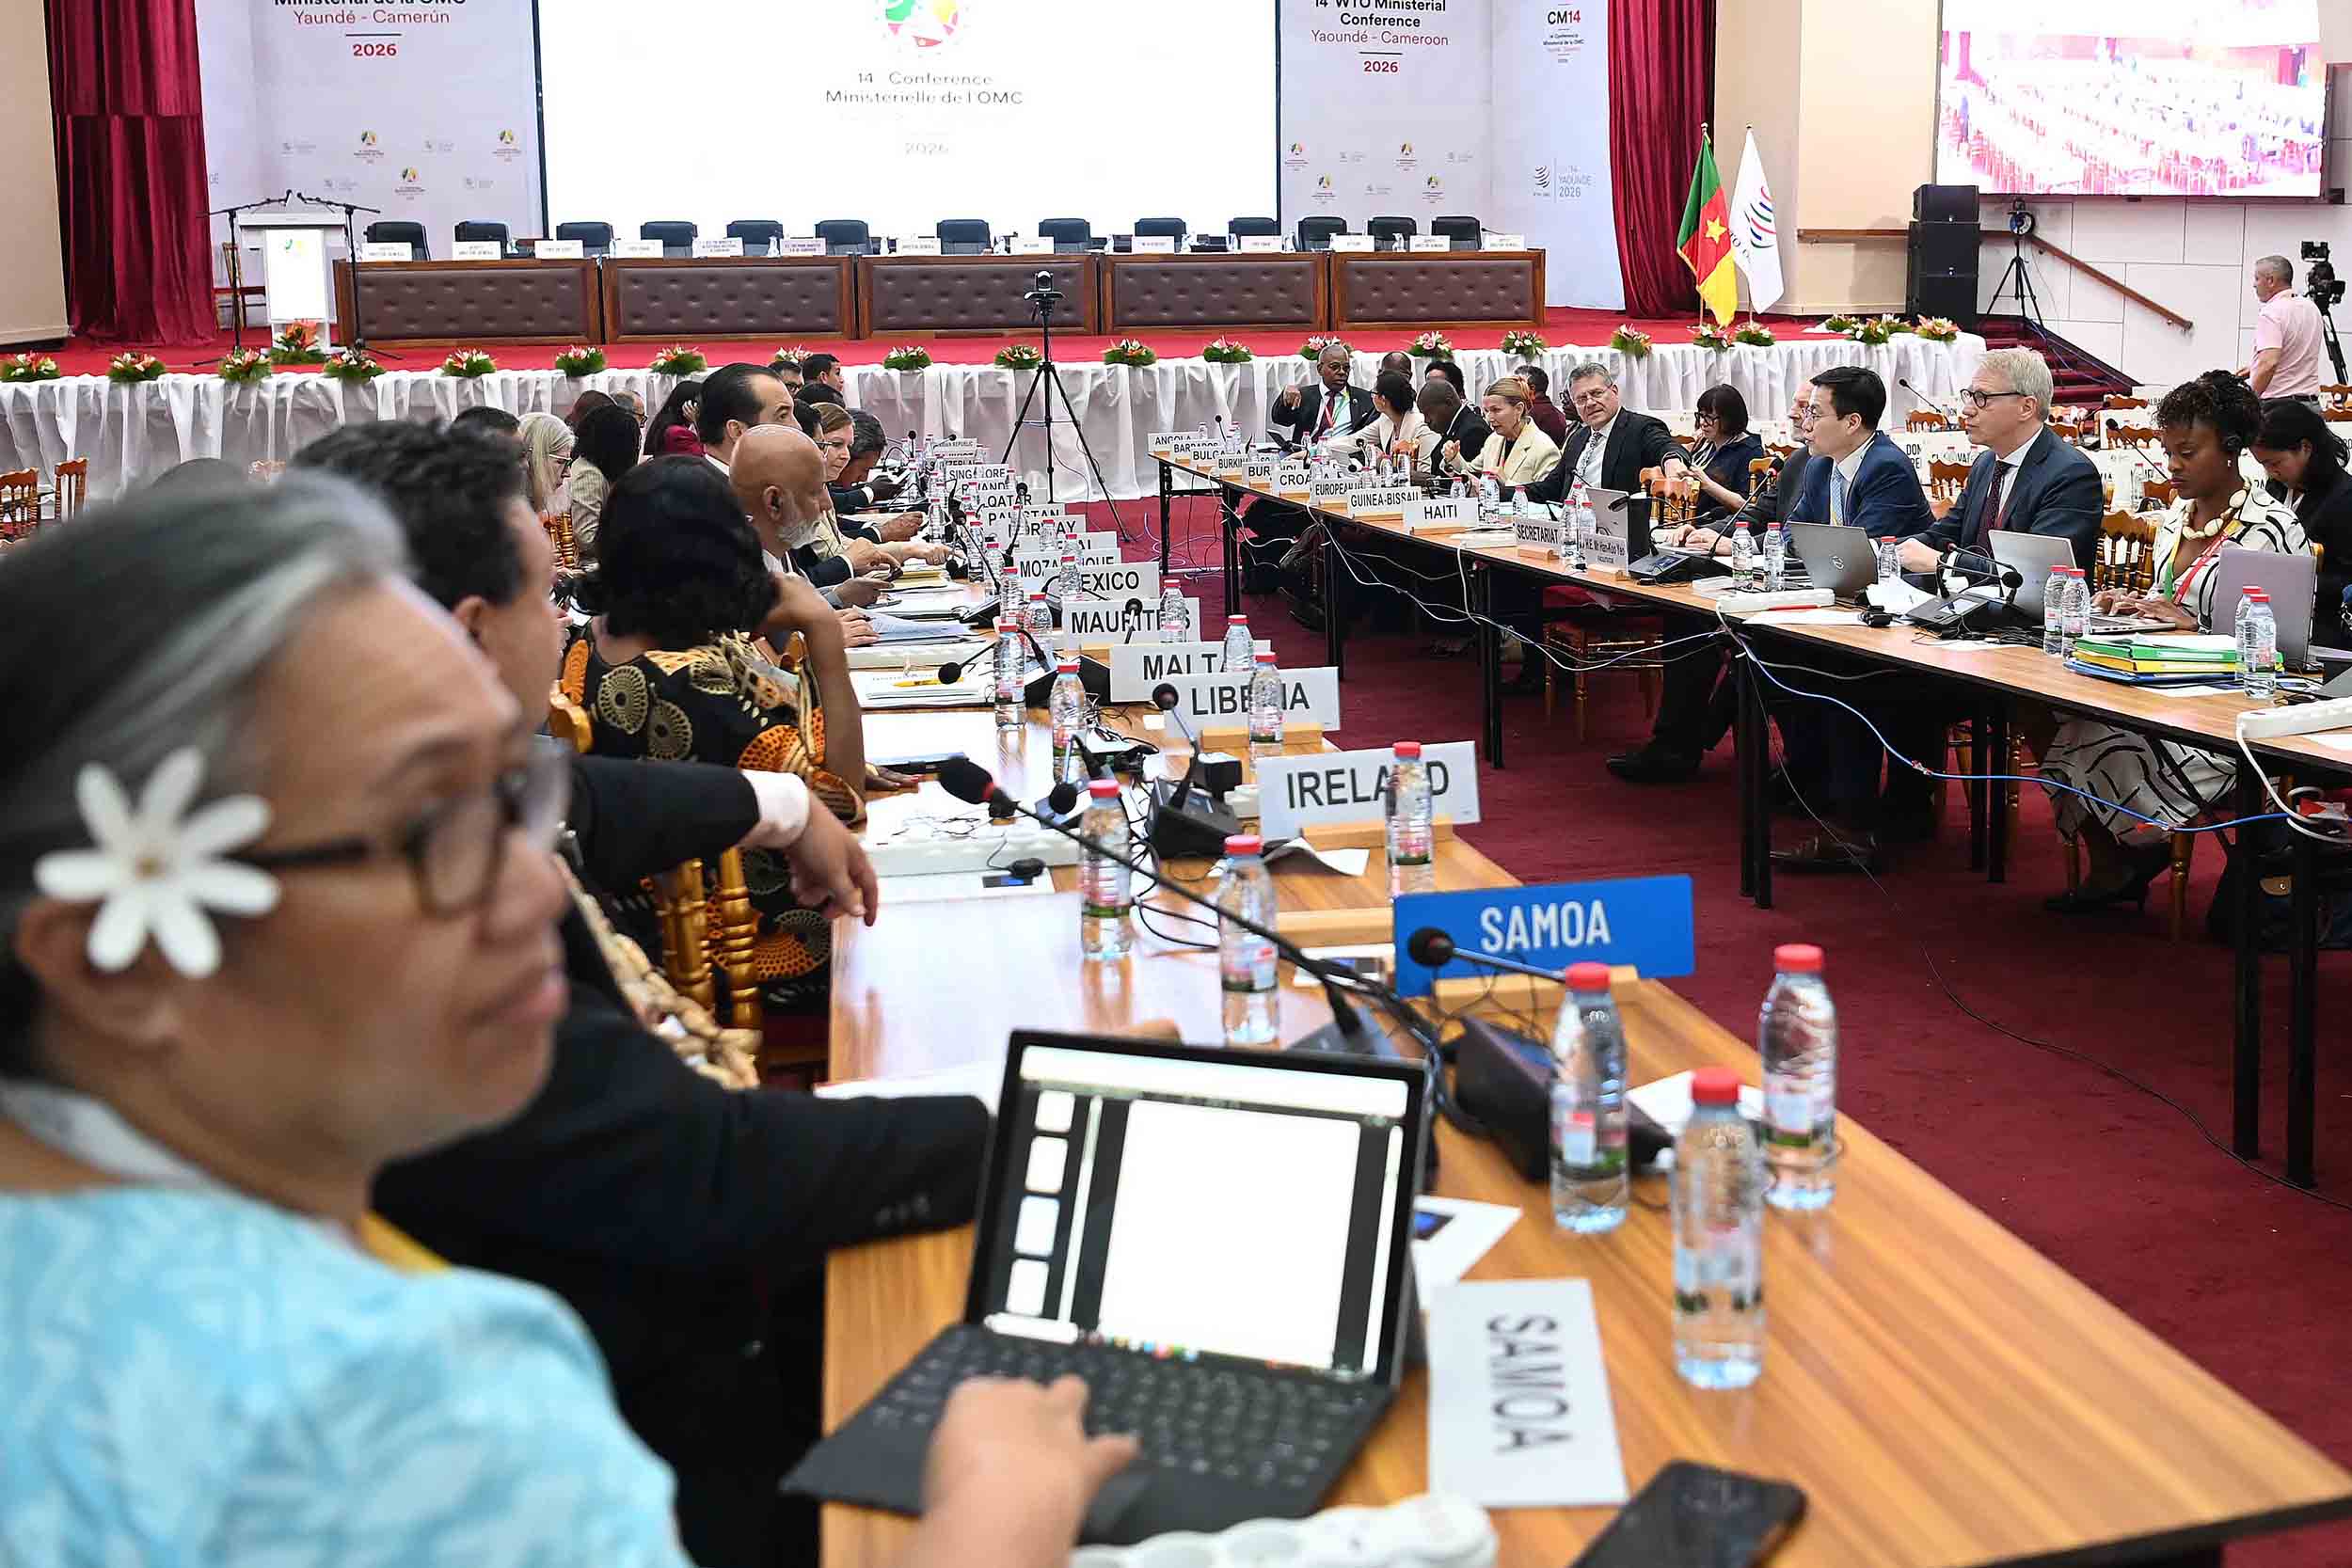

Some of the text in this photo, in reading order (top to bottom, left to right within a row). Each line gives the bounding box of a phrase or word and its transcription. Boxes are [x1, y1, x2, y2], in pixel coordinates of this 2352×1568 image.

[1375, 0, 1446, 11] Ministerial
[294, 9, 356, 24] Yaundé
[373, 9, 450, 24] Camerún
[1340, 12, 1421, 27] Conference
[1548, 9, 1581, 24] CM14
[1311, 29, 1368, 43] Yaoundé
[1381, 30, 1449, 46] Cameroon
[353, 43, 397, 56] 2026
[1364, 60, 1398, 72] 2026
[949, 468, 1006, 481] SINGORE
[1423, 503, 1458, 520] HAITI
[1517, 524, 1559, 545] SECRETARIAT
[1081, 571, 1139, 592] EXICO
[1071, 609, 1191, 634] MAUITI
[1191, 682, 1311, 716] LIBEIA
[1286, 760, 1450, 810] IRELAD
[1480, 899, 1612, 954] SAMOA
[1486, 1314, 1577, 1454] SAMOA
